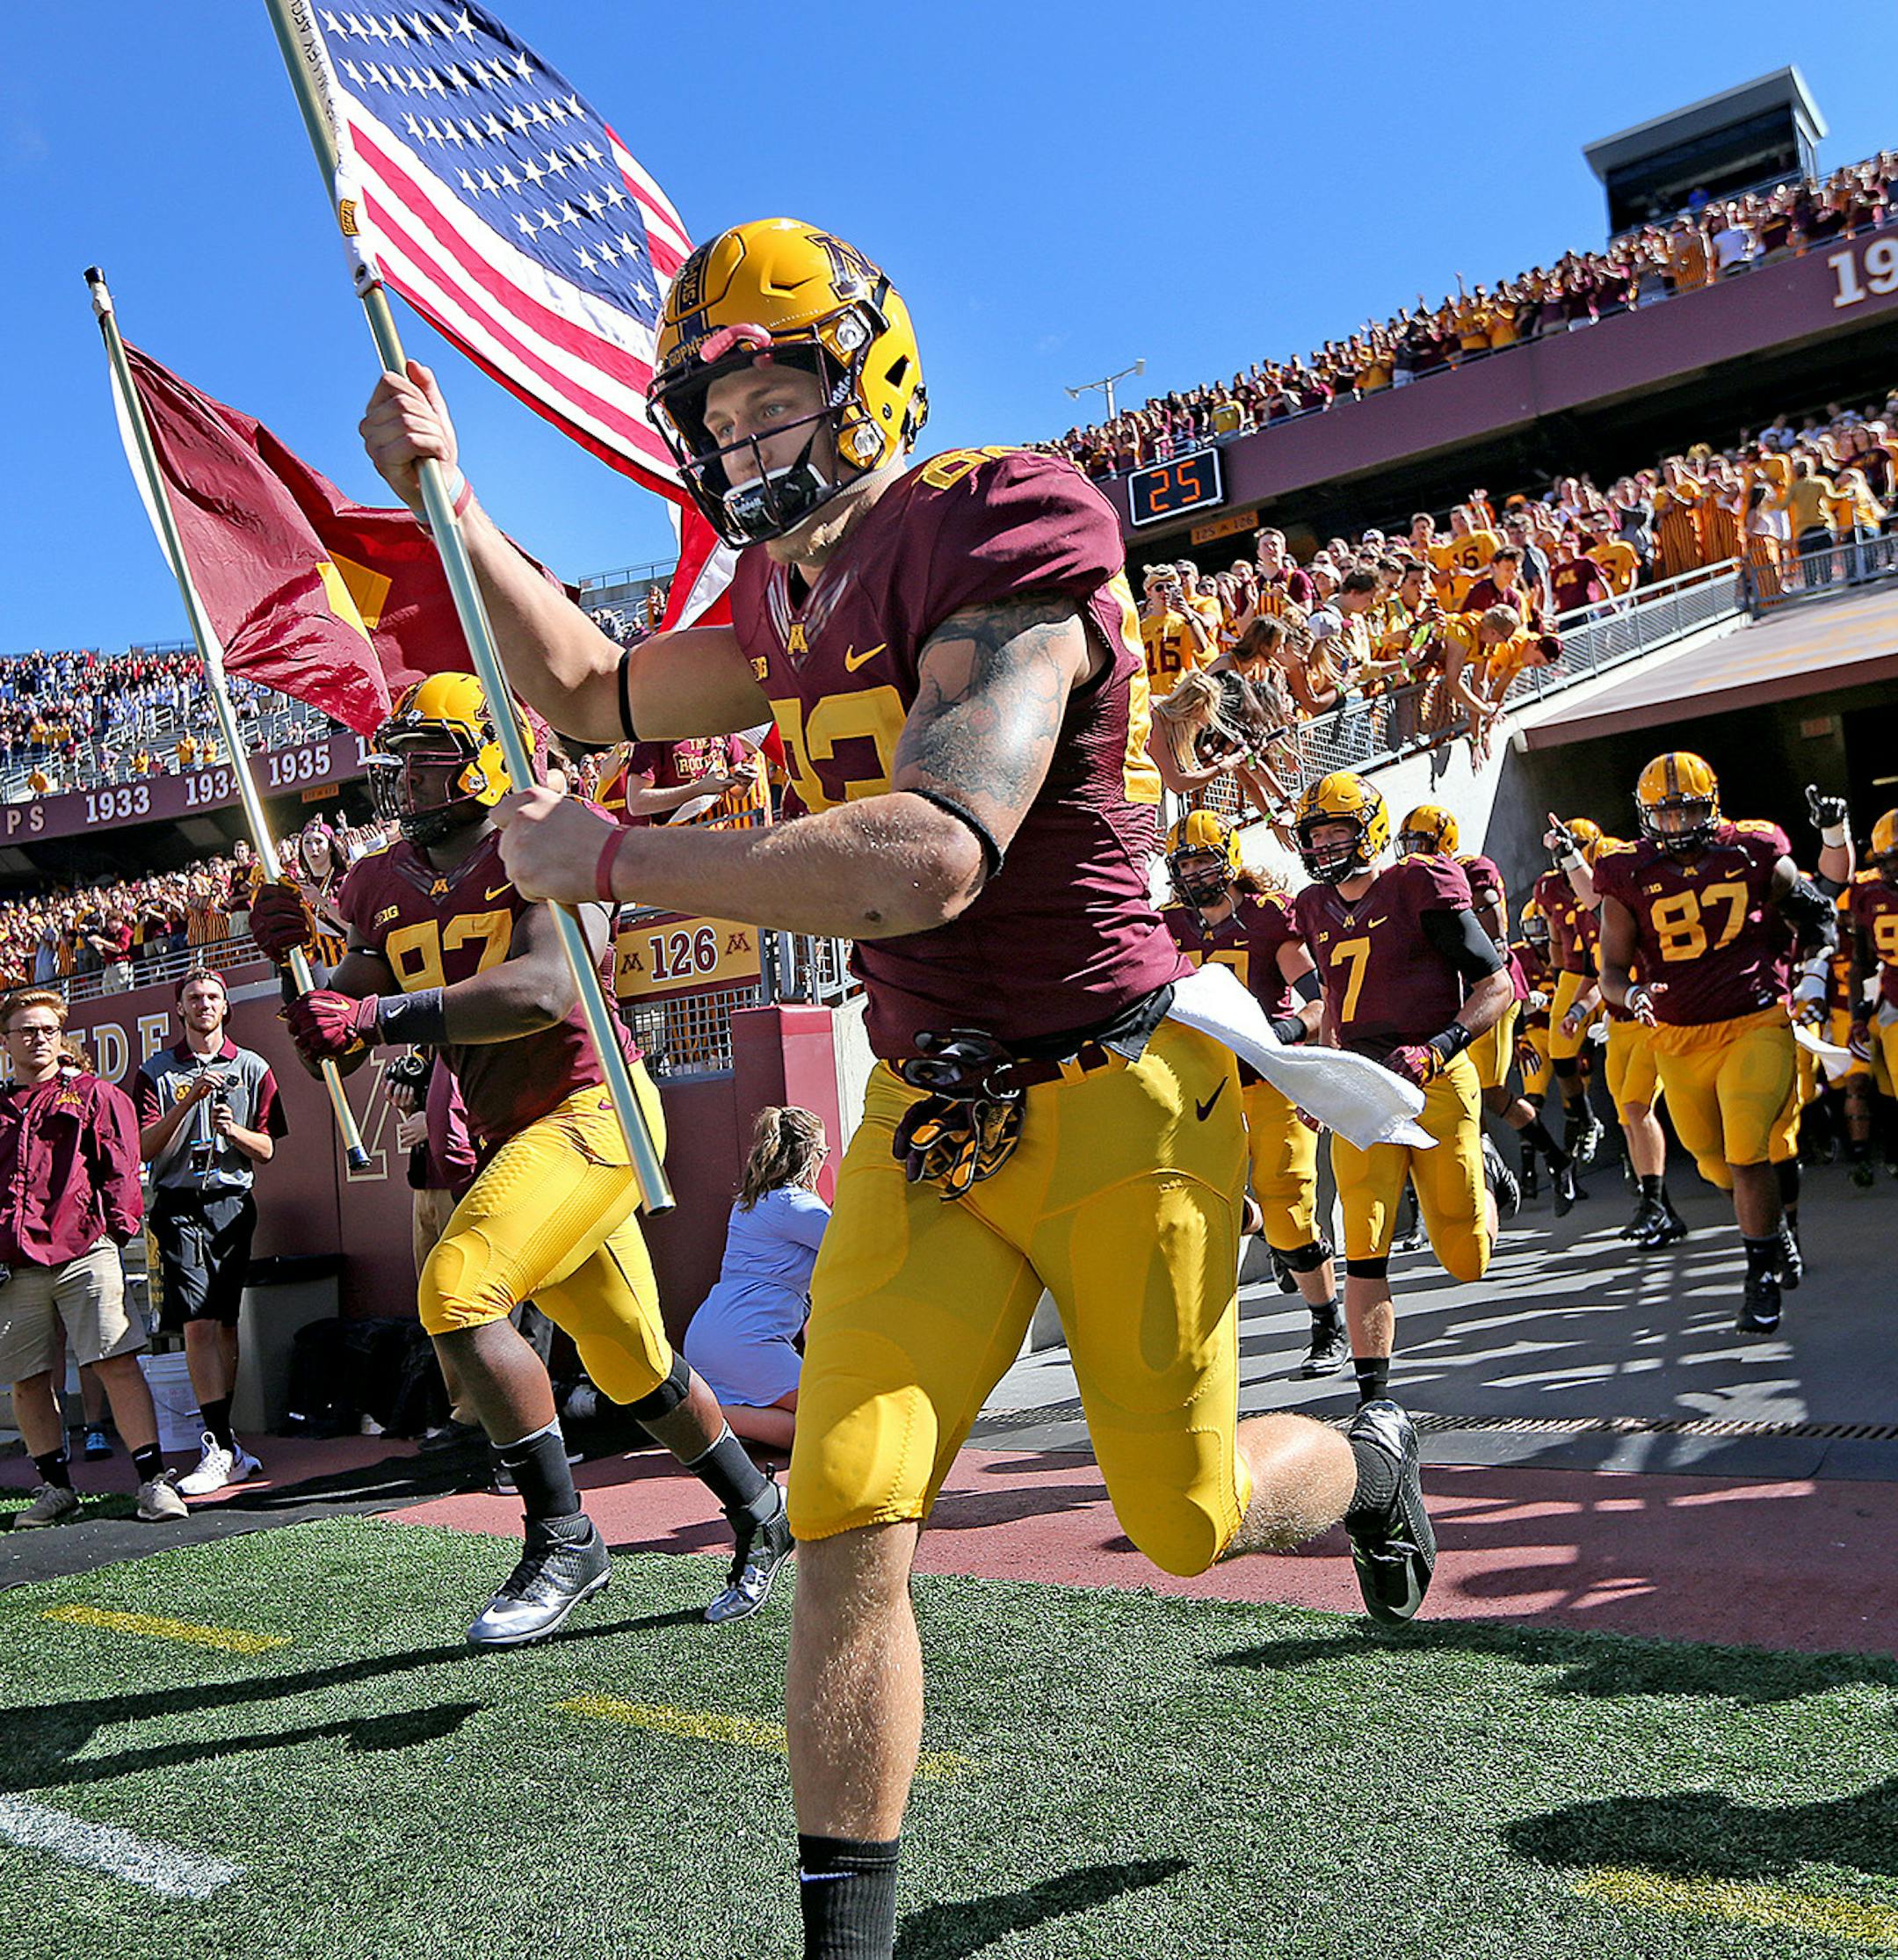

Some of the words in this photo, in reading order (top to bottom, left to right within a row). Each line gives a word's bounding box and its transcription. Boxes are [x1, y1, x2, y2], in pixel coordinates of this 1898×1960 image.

[1828, 238, 1898, 308] 19
[669, 329, 721, 367] GOPHE
[1149, 461, 1201, 512] 25
[1144, 636, 1181, 677] 16
[85, 785, 151, 824] 1933
[268, 743, 331, 787] 1935
[385, 907, 513, 993] 97
[648, 926, 719, 983] 126
[1650, 881, 1749, 963] 87
[1329, 936, 1371, 1023] 7
